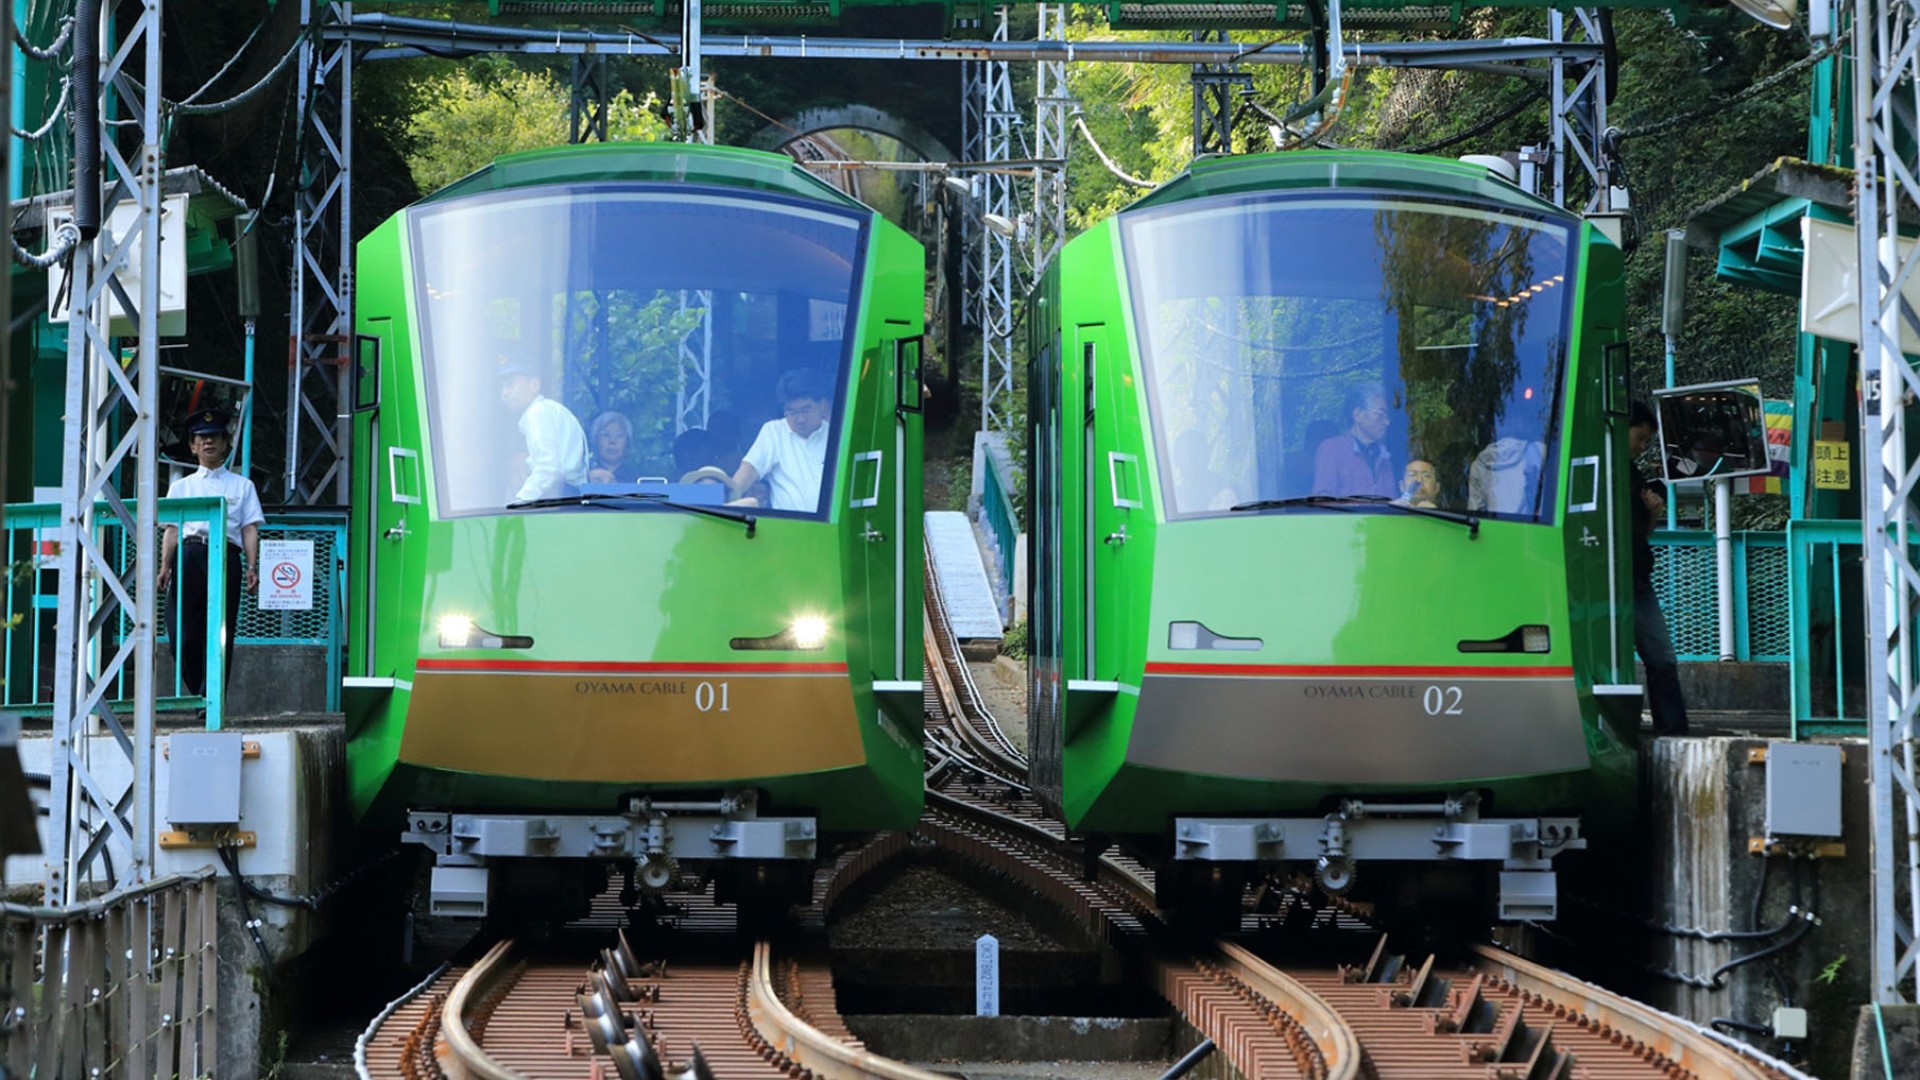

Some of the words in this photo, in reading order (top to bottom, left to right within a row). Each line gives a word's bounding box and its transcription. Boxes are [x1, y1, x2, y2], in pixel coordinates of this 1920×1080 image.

[1816, 445, 1847, 460] 頭上
[1816, 469, 1848, 484] 注意
[575, 682, 636, 695] OYAMA
[640, 681, 687, 695] CABLE
[695, 681, 730, 712] 01
[1304, 685, 1365, 699] OYAMA
[1369, 685, 1417, 699] CABLE
[1423, 685, 1463, 716] 02
